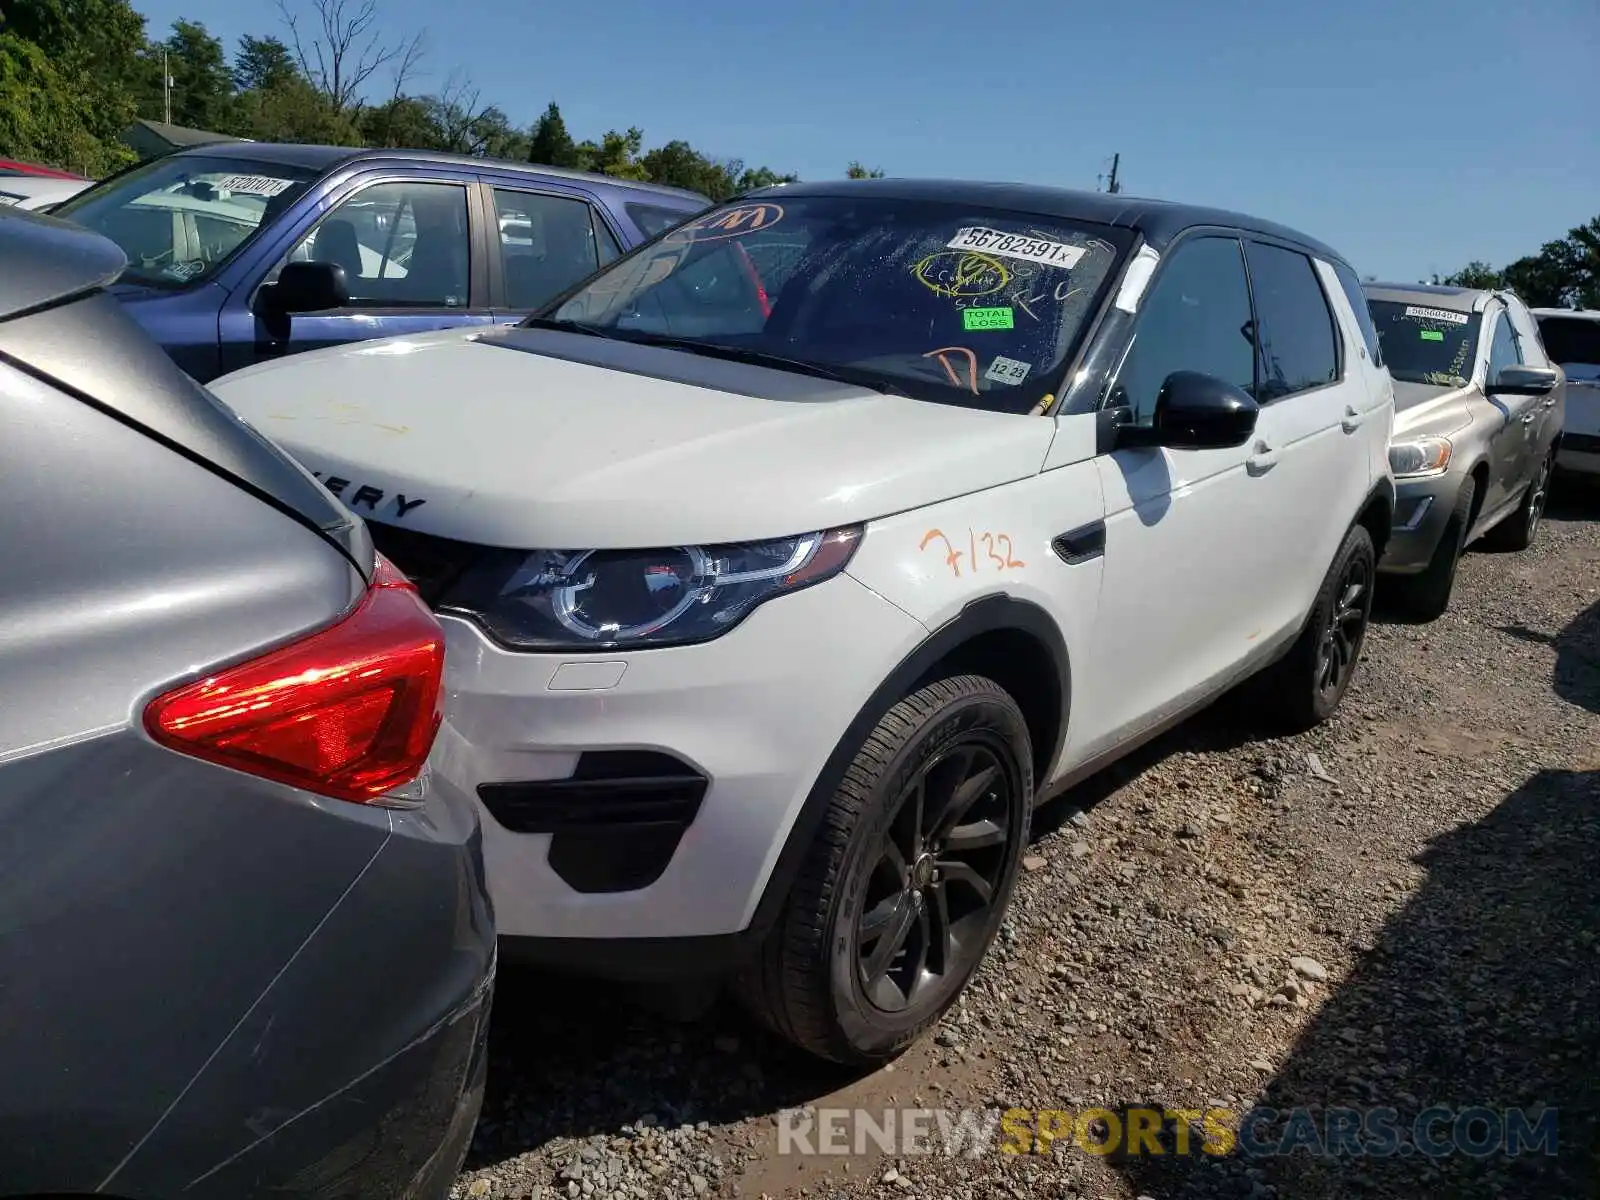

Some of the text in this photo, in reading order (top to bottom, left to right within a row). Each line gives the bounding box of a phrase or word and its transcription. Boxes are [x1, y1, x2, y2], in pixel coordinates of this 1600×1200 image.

[967, 310, 1009, 318] TOTAL
[970, 319, 1008, 327] LOSS
[991, 363, 1025, 378] 12 23
